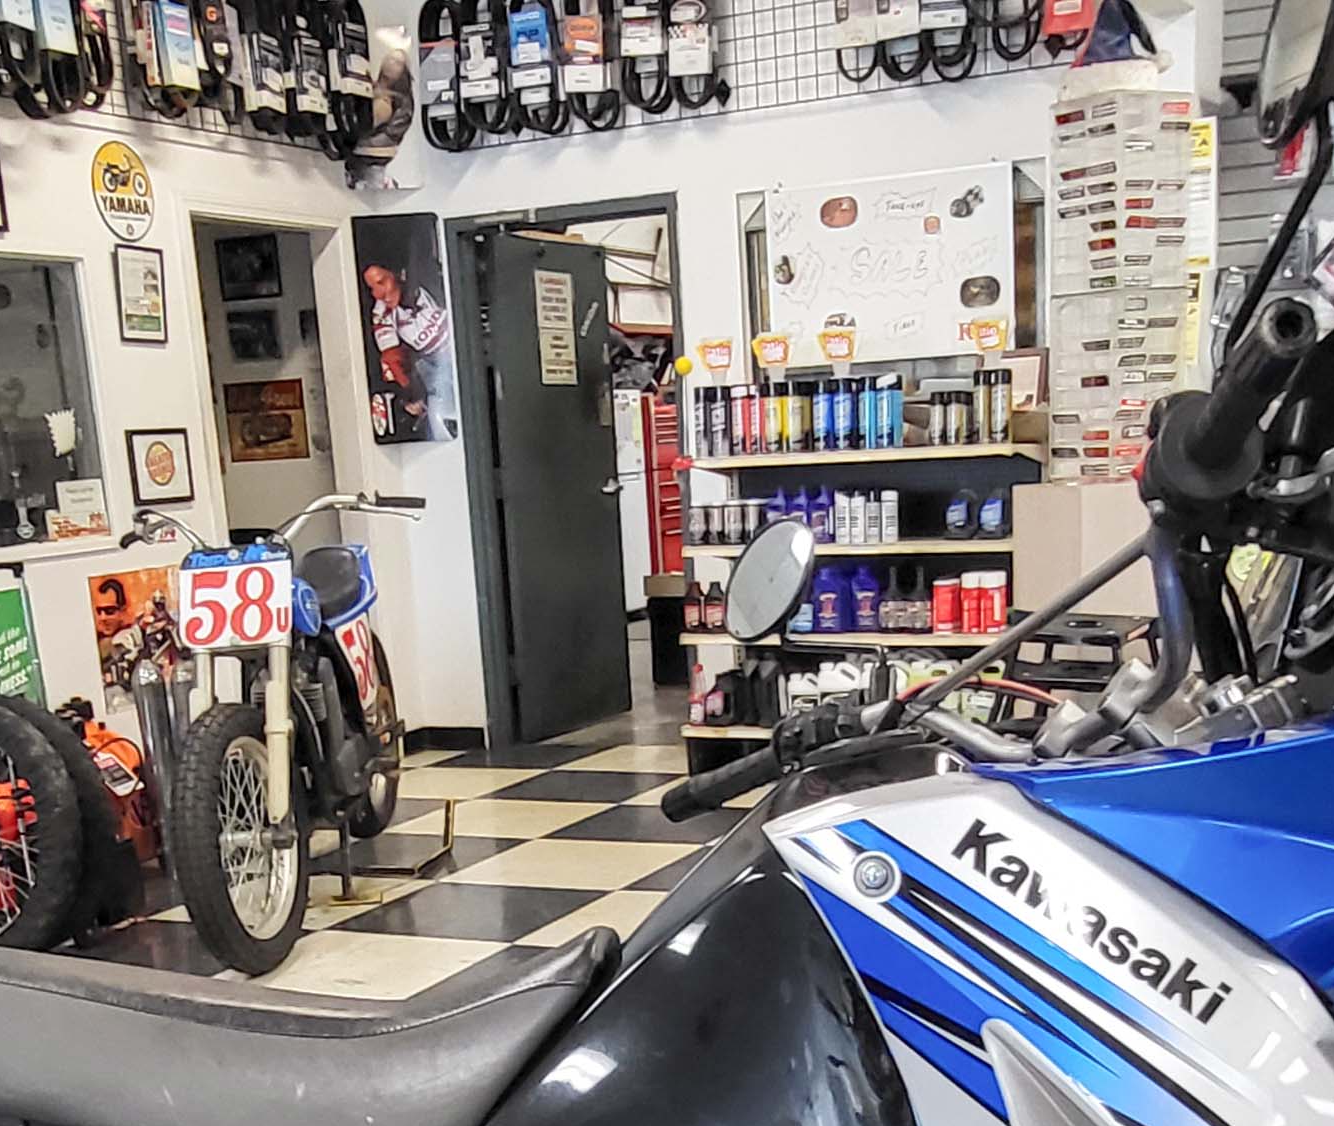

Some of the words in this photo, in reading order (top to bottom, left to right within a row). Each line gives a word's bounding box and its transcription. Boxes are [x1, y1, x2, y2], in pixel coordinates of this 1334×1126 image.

[100, 195, 151, 216] YAMAHA
[185, 566, 275, 647] 58
[951, 818, 1233, 1024] Kawasaki
